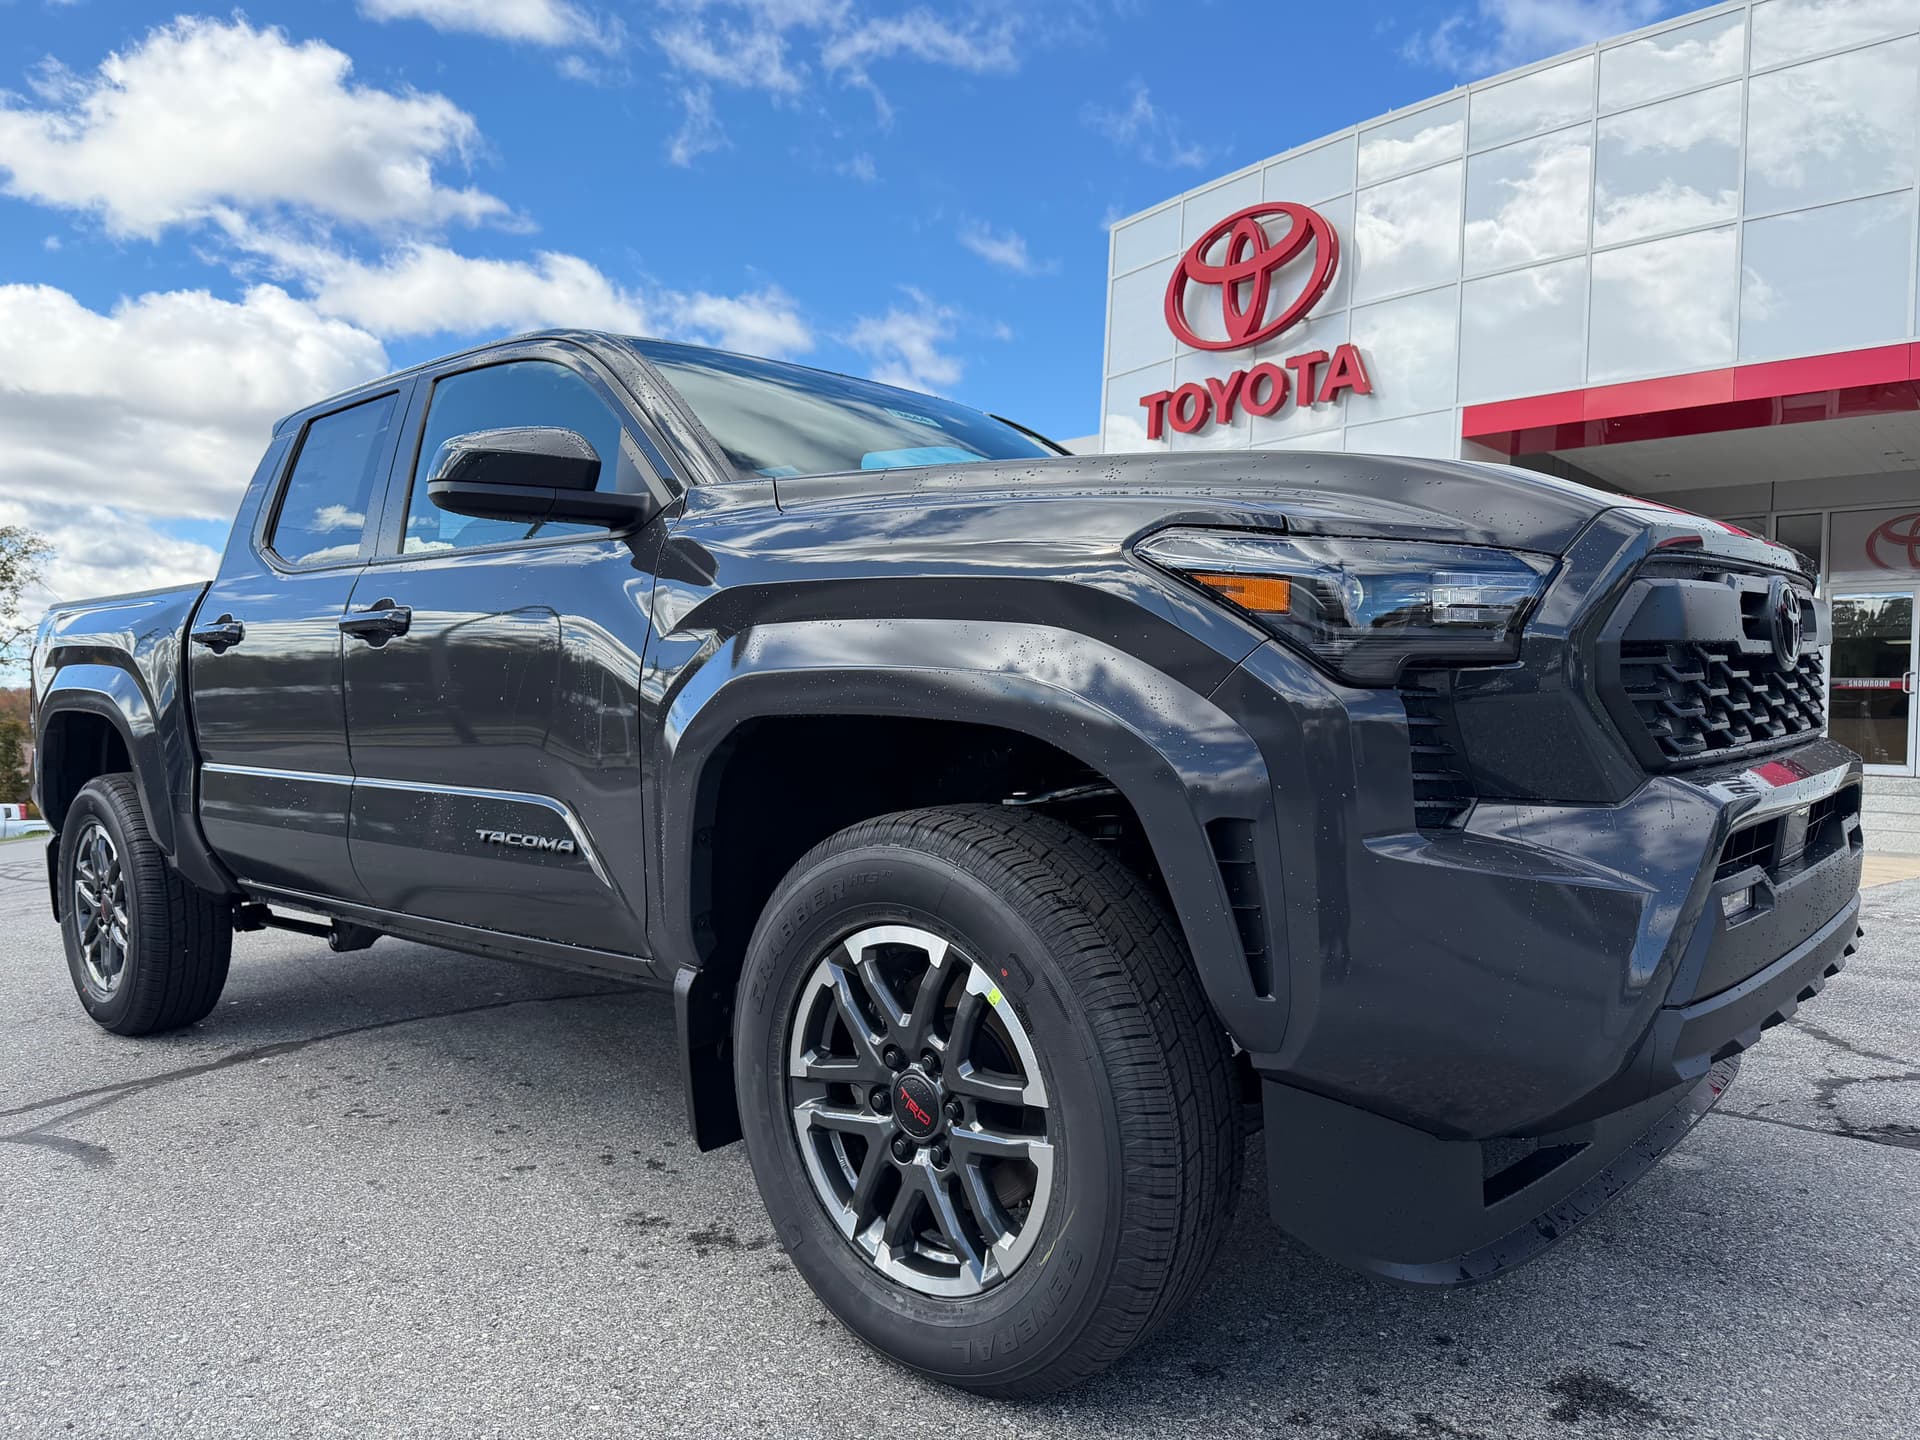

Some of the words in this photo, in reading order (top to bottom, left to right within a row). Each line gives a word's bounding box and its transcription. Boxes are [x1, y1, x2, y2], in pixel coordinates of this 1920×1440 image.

[1140, 343, 1373, 440] TOYOTA
[1848, 679, 1890, 688] SHOWROOM
[475, 829, 575, 853] TACOMA
[899, 1087, 931, 1126] TRD
